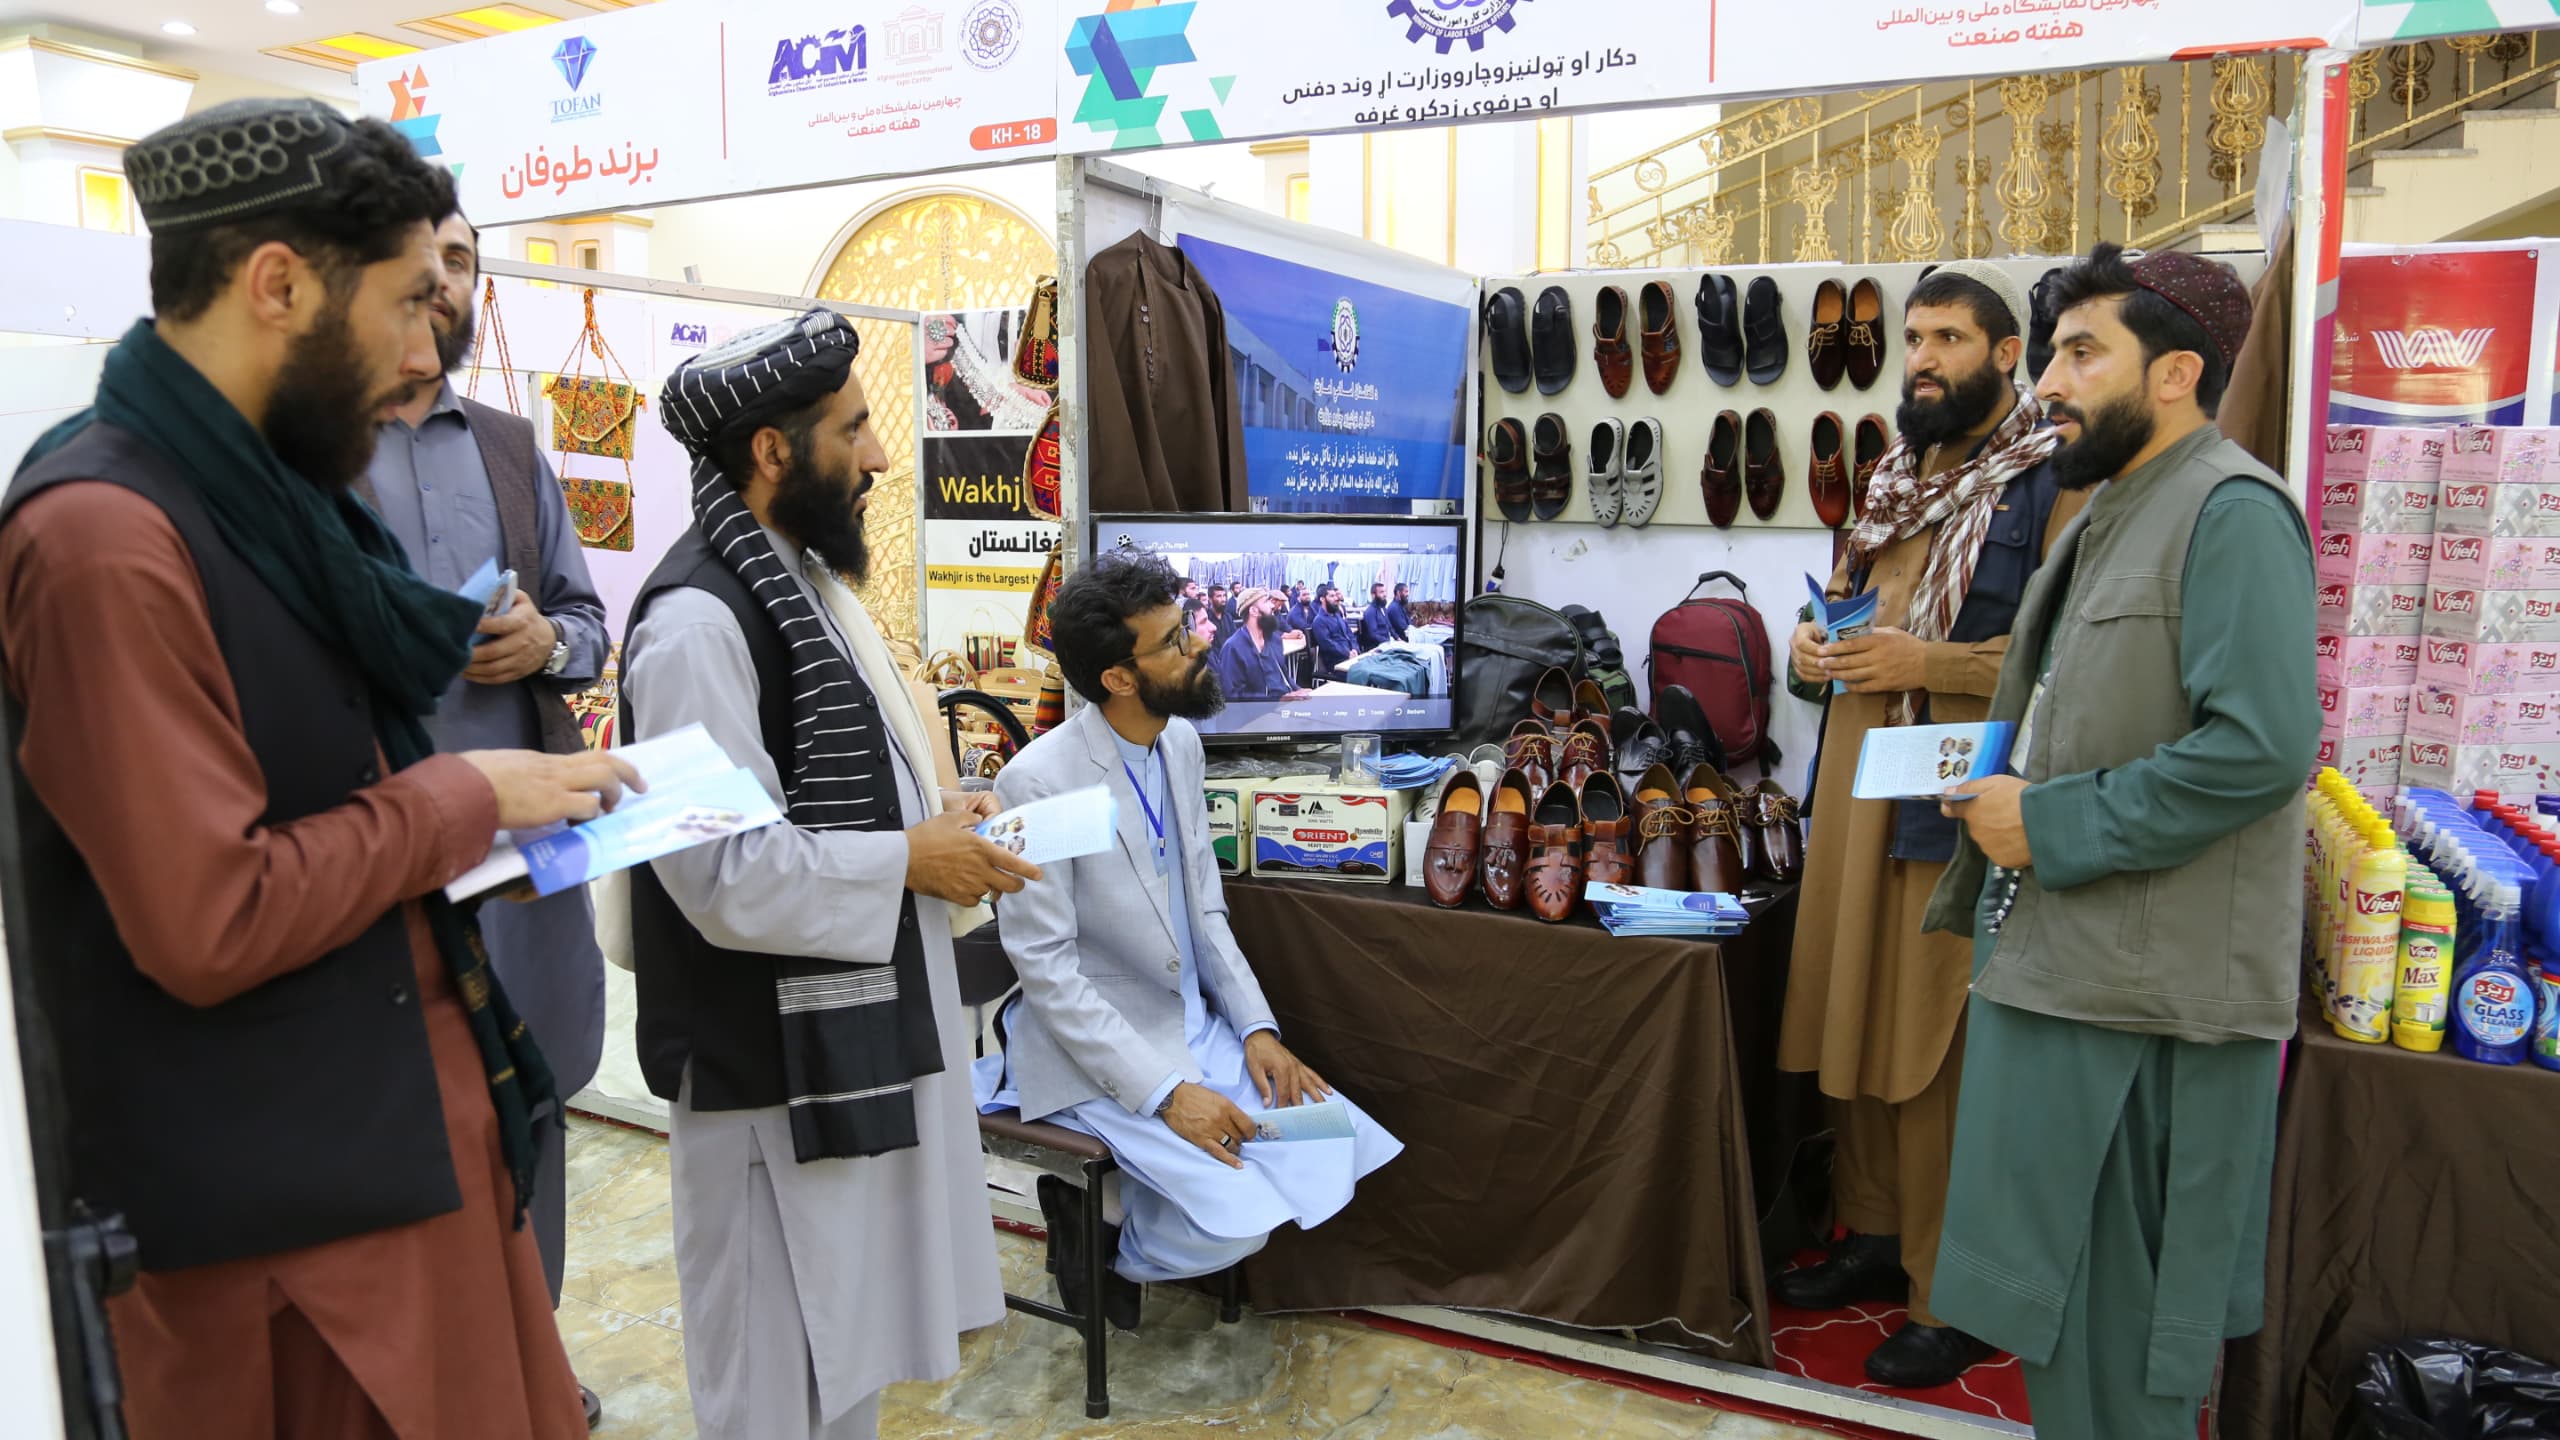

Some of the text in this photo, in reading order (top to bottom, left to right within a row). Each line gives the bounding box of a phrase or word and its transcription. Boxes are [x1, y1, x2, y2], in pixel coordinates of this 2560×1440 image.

[1968, 4, 2000, 22] ملی
[1435, 28, 1444, 37] OF
[1443, 29, 1463, 39] LABOR
[1469, 20, 1491, 36] SOCIAL
[1948, 20, 2083, 47] هفته صنعت
[1571, 50, 1590, 76] او
[551, 93, 602, 116] TOFAN
[847, 115, 921, 137] هفته صنعت
[991, 126, 1012, 145] KH
[1023, 123, 1041, 141] 18
[502, 140, 659, 200] برند طوفان
[2327, 430, 2364, 453] Vijeh
[938, 474, 1026, 512] Wakhj
[2405, 491, 2428, 508] ویژه
[2448, 485, 2486, 507] Vijeh
[2540, 493, 2560, 510] یژه
[968, 530, 1062, 558] غانستان
[2320, 535, 2350, 558] ijeh
[2442, 539, 2480, 561] Vijeh
[928, 570, 963, 584] Wakhjir
[965, 571, 974, 582] is
[976, 572, 991, 583] the
[993, 573, 1030, 586] Largest
[2392, 594, 2415, 611] ویژه
[2435, 591, 2473, 613] Vijeh
[2526, 600, 2552, 617] ویژه
[2429, 642, 2466, 664] Vijeh
[2531, 652, 2556, 668] ویژه
[2519, 703, 2544, 718] ویژه
[2411, 743, 2449, 767] Vijeh
[2500, 754, 2525, 769] ویژه
[1296, 830, 1346, 841] ORIENT
[2357, 891, 2401, 914] Vijeh
[2352, 945, 2395, 957] LIQUID
[2402, 966, 2439, 985] Max
[2475, 983, 2511, 1001] ویژه
[2474, 1003, 2525, 1021] GLASS
[2480, 1015, 2524, 1028] CLEANER
